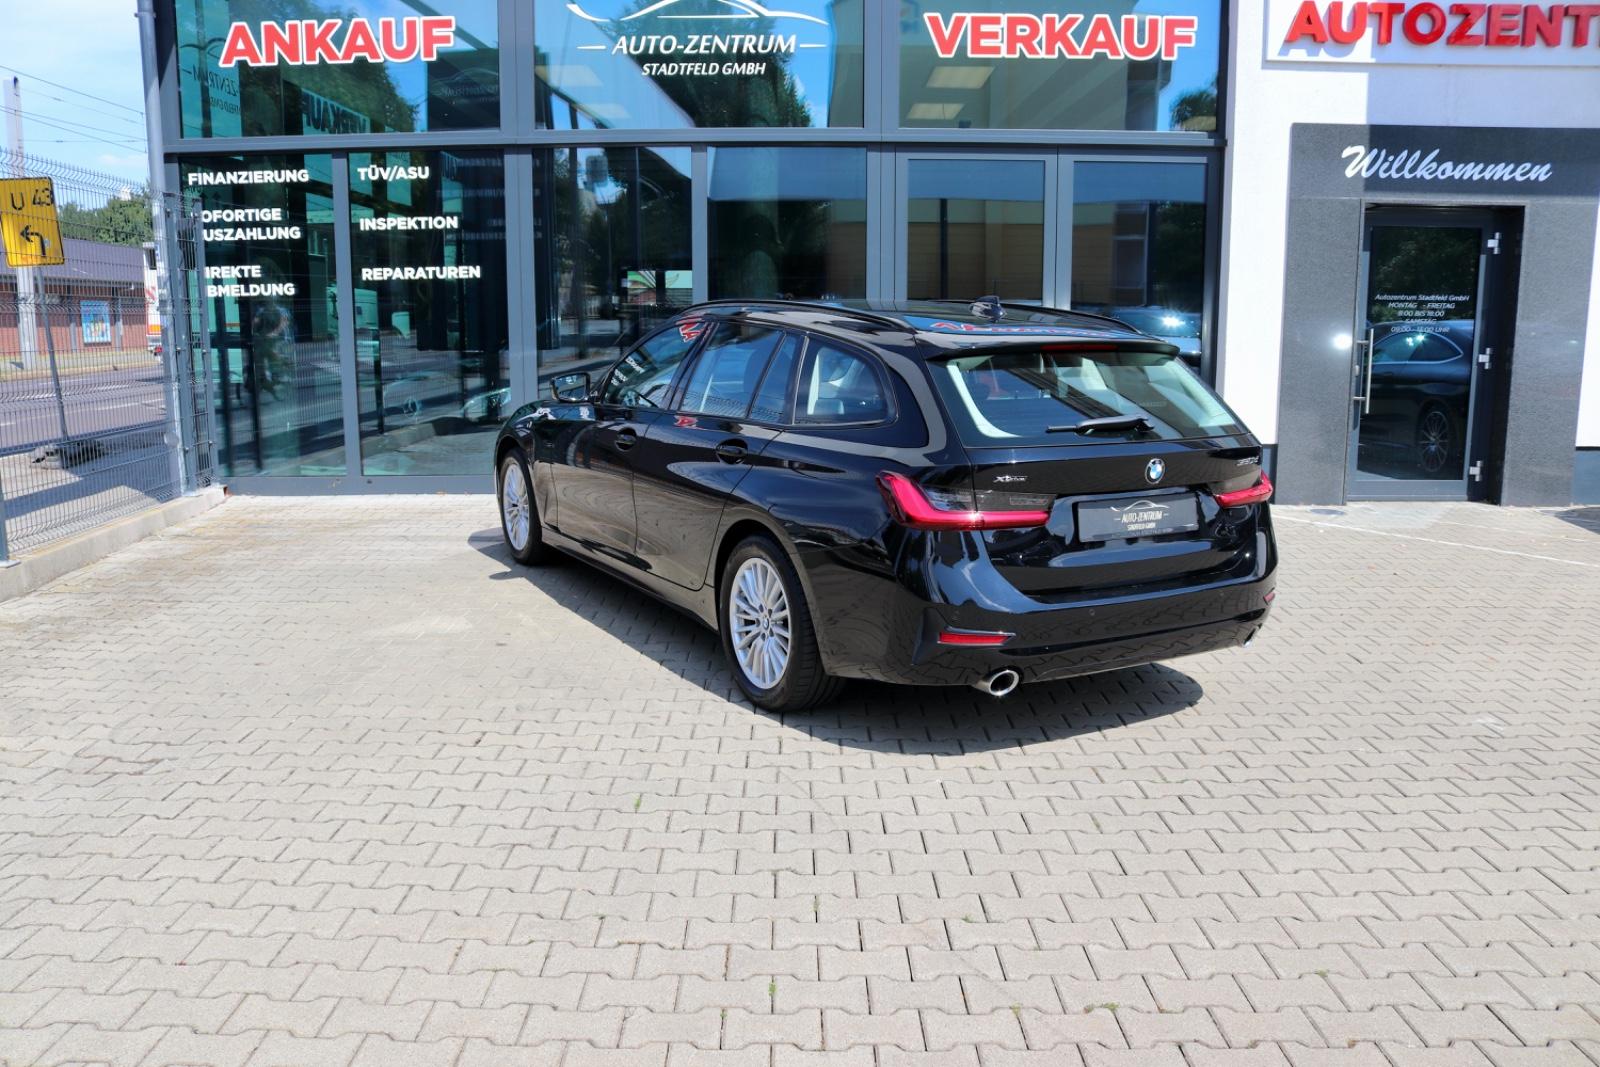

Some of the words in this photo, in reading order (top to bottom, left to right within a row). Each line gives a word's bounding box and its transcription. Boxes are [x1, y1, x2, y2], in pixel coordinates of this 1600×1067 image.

[1284, 1, 1600, 47] AUTOZENT
[219, 16, 456, 67] ANKAUF
[611, 34, 797, 55] AUTO-ZENTRUM
[923, 13, 1198, 61] VERKAUF
[642, 62, 719, 76] STADTFELD
[721, 62, 766, 75] GMBH
[1341, 145, 1552, 182] Willkommen
[188, 169, 309, 185] FINANZIERUNG
[357, 165, 429, 181] TÜV/ASU
[10, 192, 25, 210] U
[202, 207, 282, 222] OFORTIGE
[360, 216, 458, 231] INSPEKTION
[203, 226, 301, 241] USZAHLUNG
[204, 265, 261, 279] IREKTE
[361, 265, 481, 280] REPARATUREN
[206, 283, 296, 297] BMELDUNG
